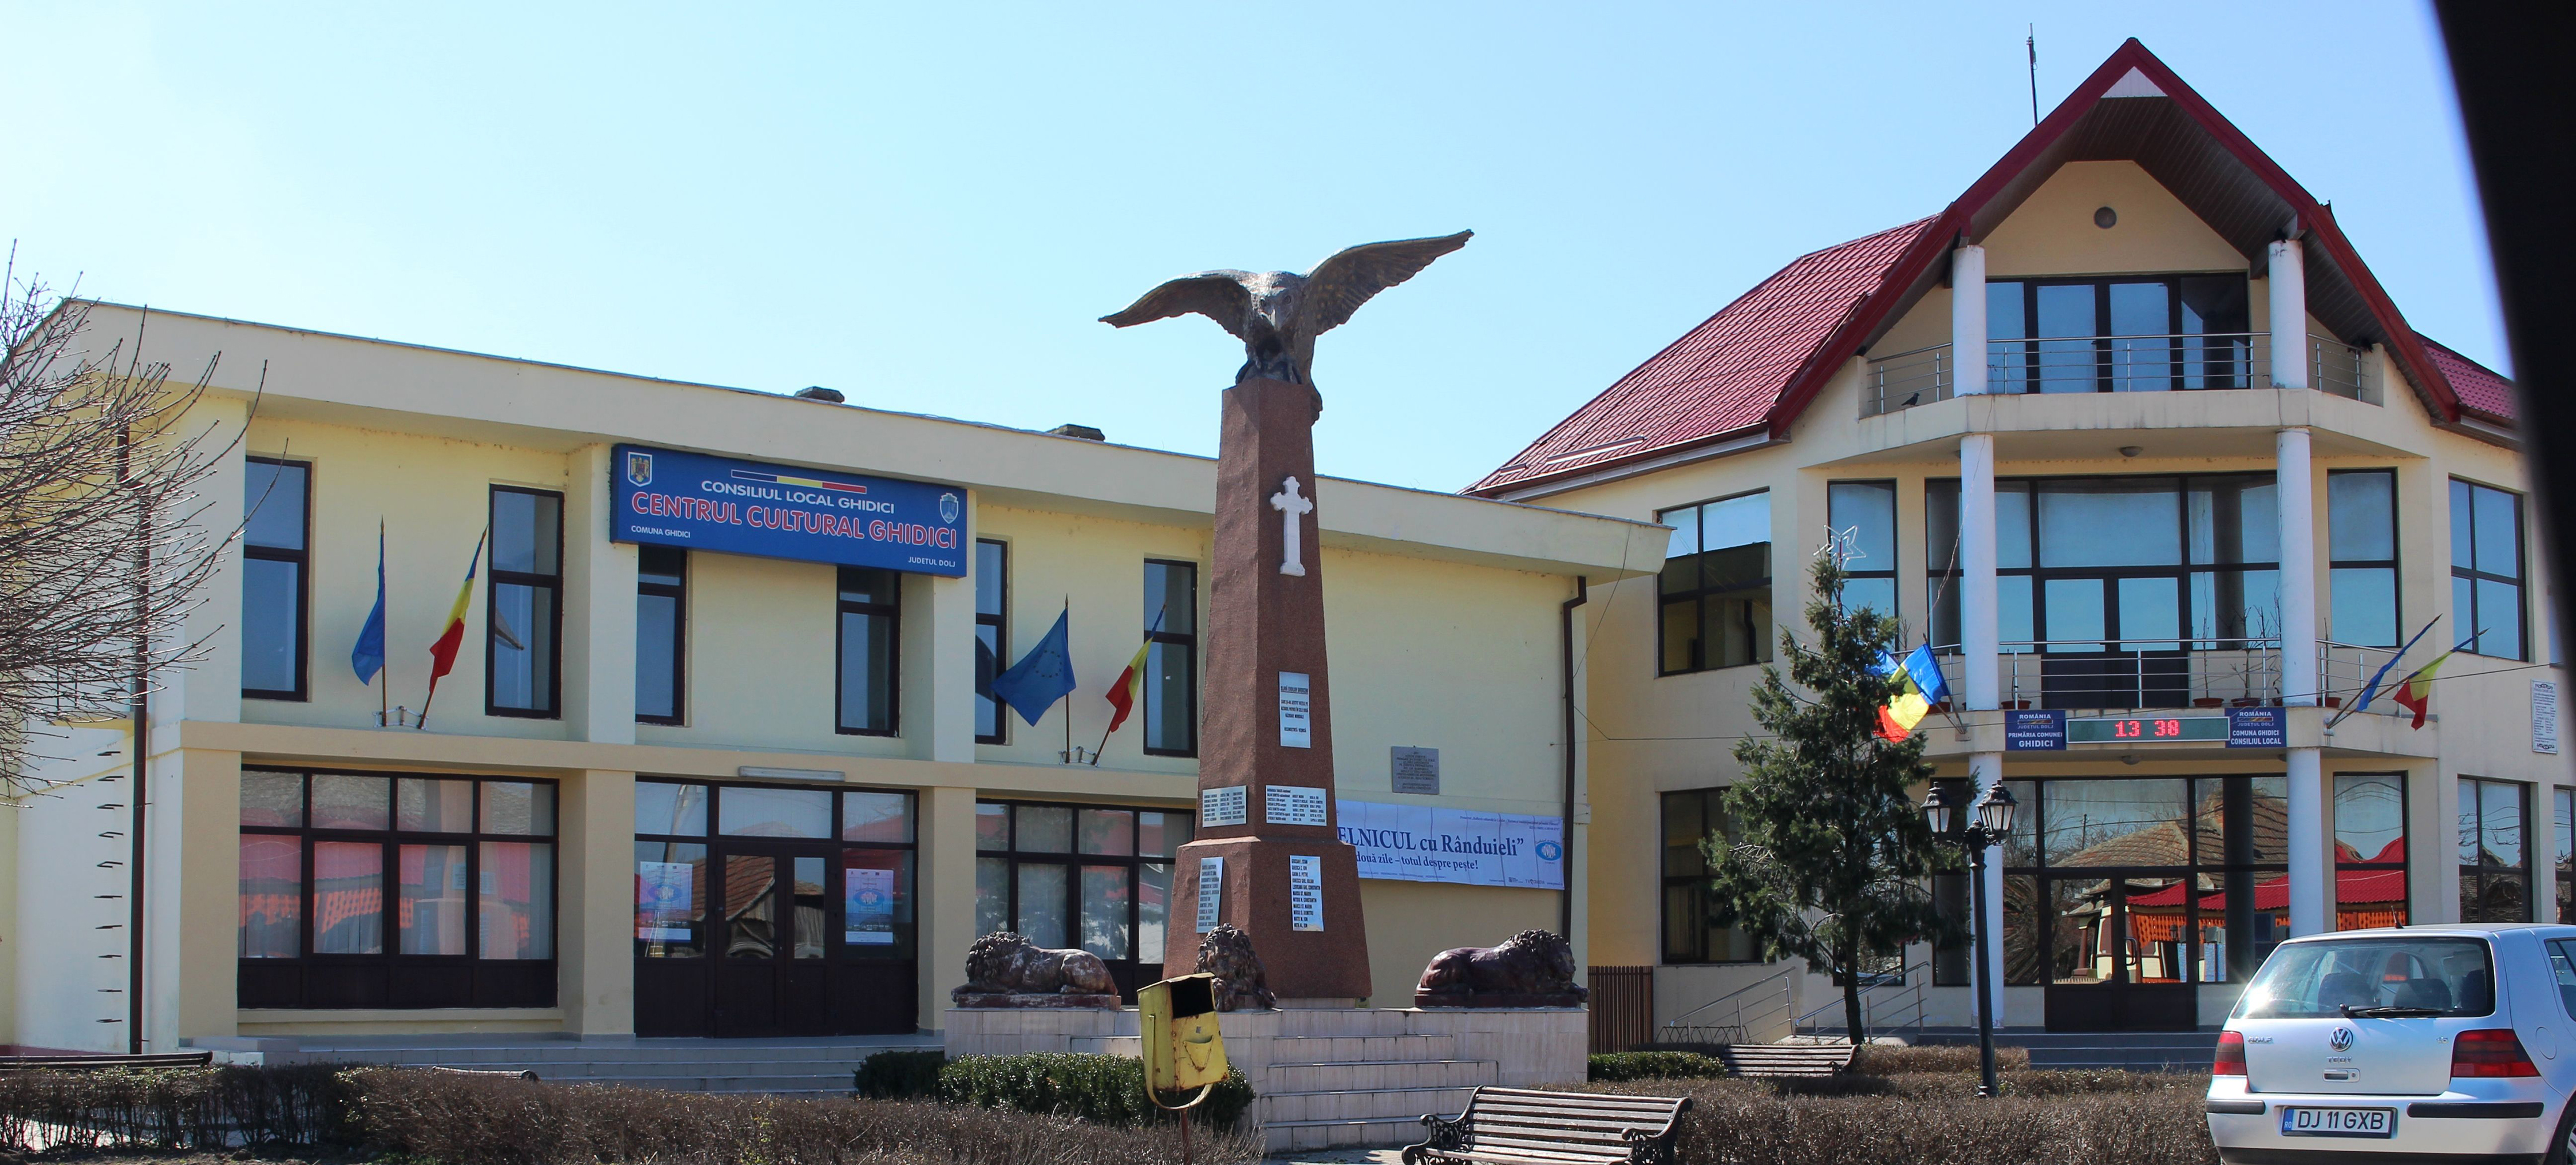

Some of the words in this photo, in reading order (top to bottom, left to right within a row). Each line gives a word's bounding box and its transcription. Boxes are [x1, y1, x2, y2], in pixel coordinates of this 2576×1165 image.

[701, 480, 782, 501] CONSILIUL
[786, 490, 835, 507] LOCAL
[837, 496, 894, 514] GHIDICI
[632, 491, 742, 526] CENTRUL
[747, 506, 865, 539] CULTURAL
[870, 520, 957, 549] GHIDICI
[631, 525, 663, 535] COMUNA
[665, 529, 690, 538] GHIDICI
[908, 556, 937, 566] JUDETUL
[938, 559, 956, 567] DOLJ
[2115, 721, 2140, 737] 13
[2154, 720, 2180, 736] 38
[1420, 839, 1437, 852] cu
[1356, 851, 1377, 863] două
[1378, 854, 1393, 864] zile
[1401, 856, 1421, 866] totul
[1424, 856, 1451, 870] despre
[1453, 860, 1479, 871] pește!
[2298, 1111, 2321, 1128] DJ
[2327, 1111, 2339, 1129] 11
[2344, 1112, 2384, 1130] GXB
